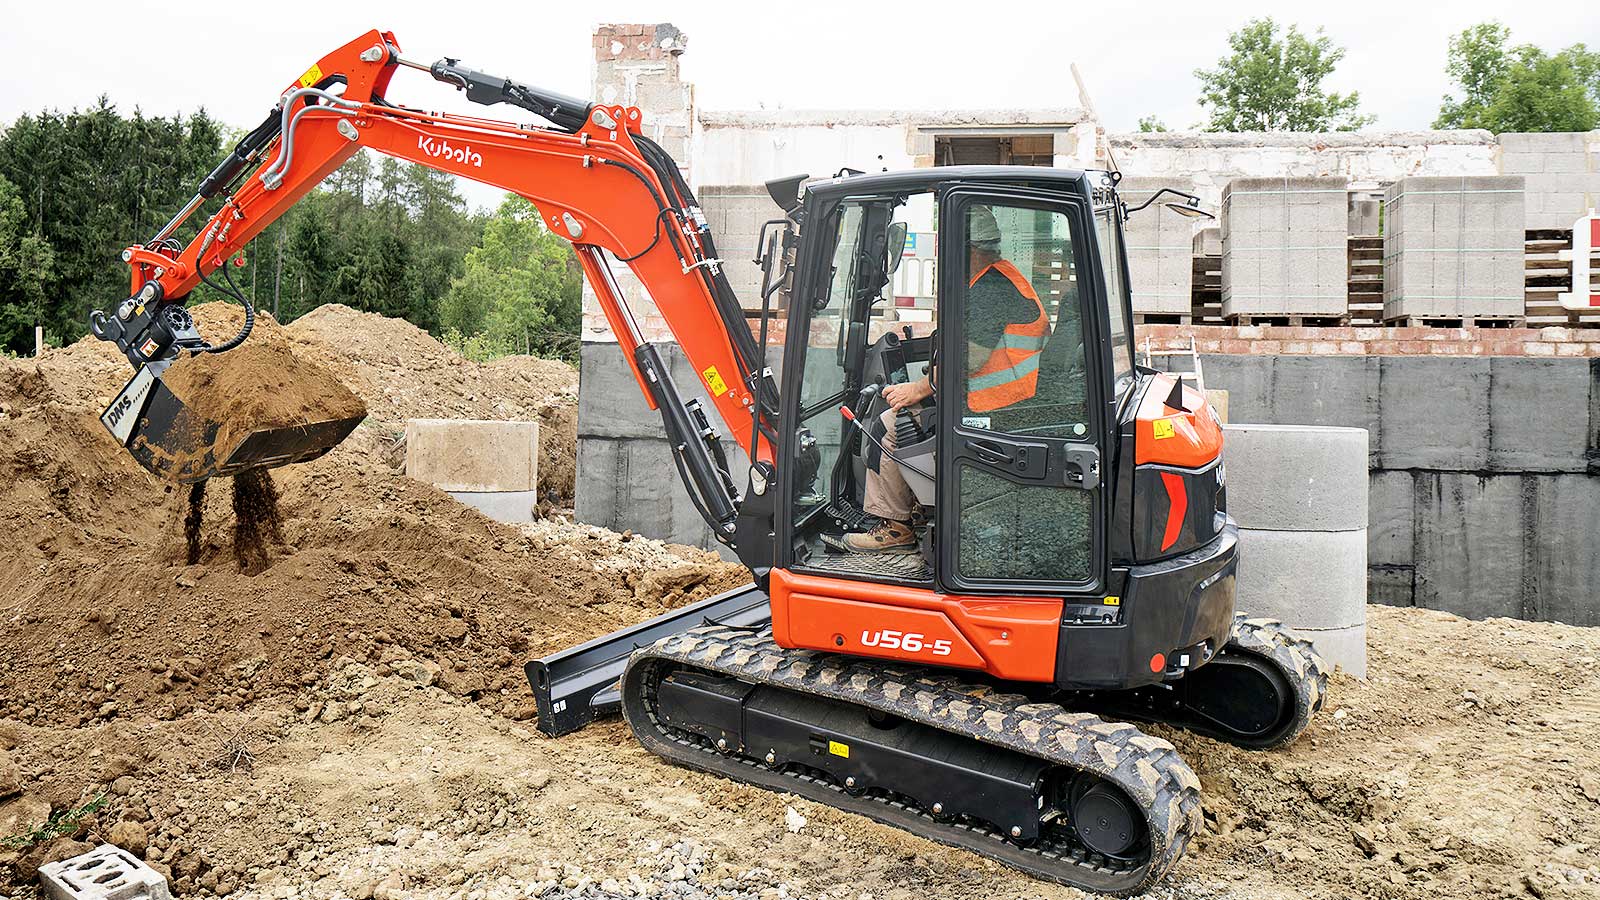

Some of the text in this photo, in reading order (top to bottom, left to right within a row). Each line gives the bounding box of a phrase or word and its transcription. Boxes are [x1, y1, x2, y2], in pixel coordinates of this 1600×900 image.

[418, 135, 483, 168] Kubota
[107, 395, 132, 428] DMS
[860, 629, 953, 656] U56-5
